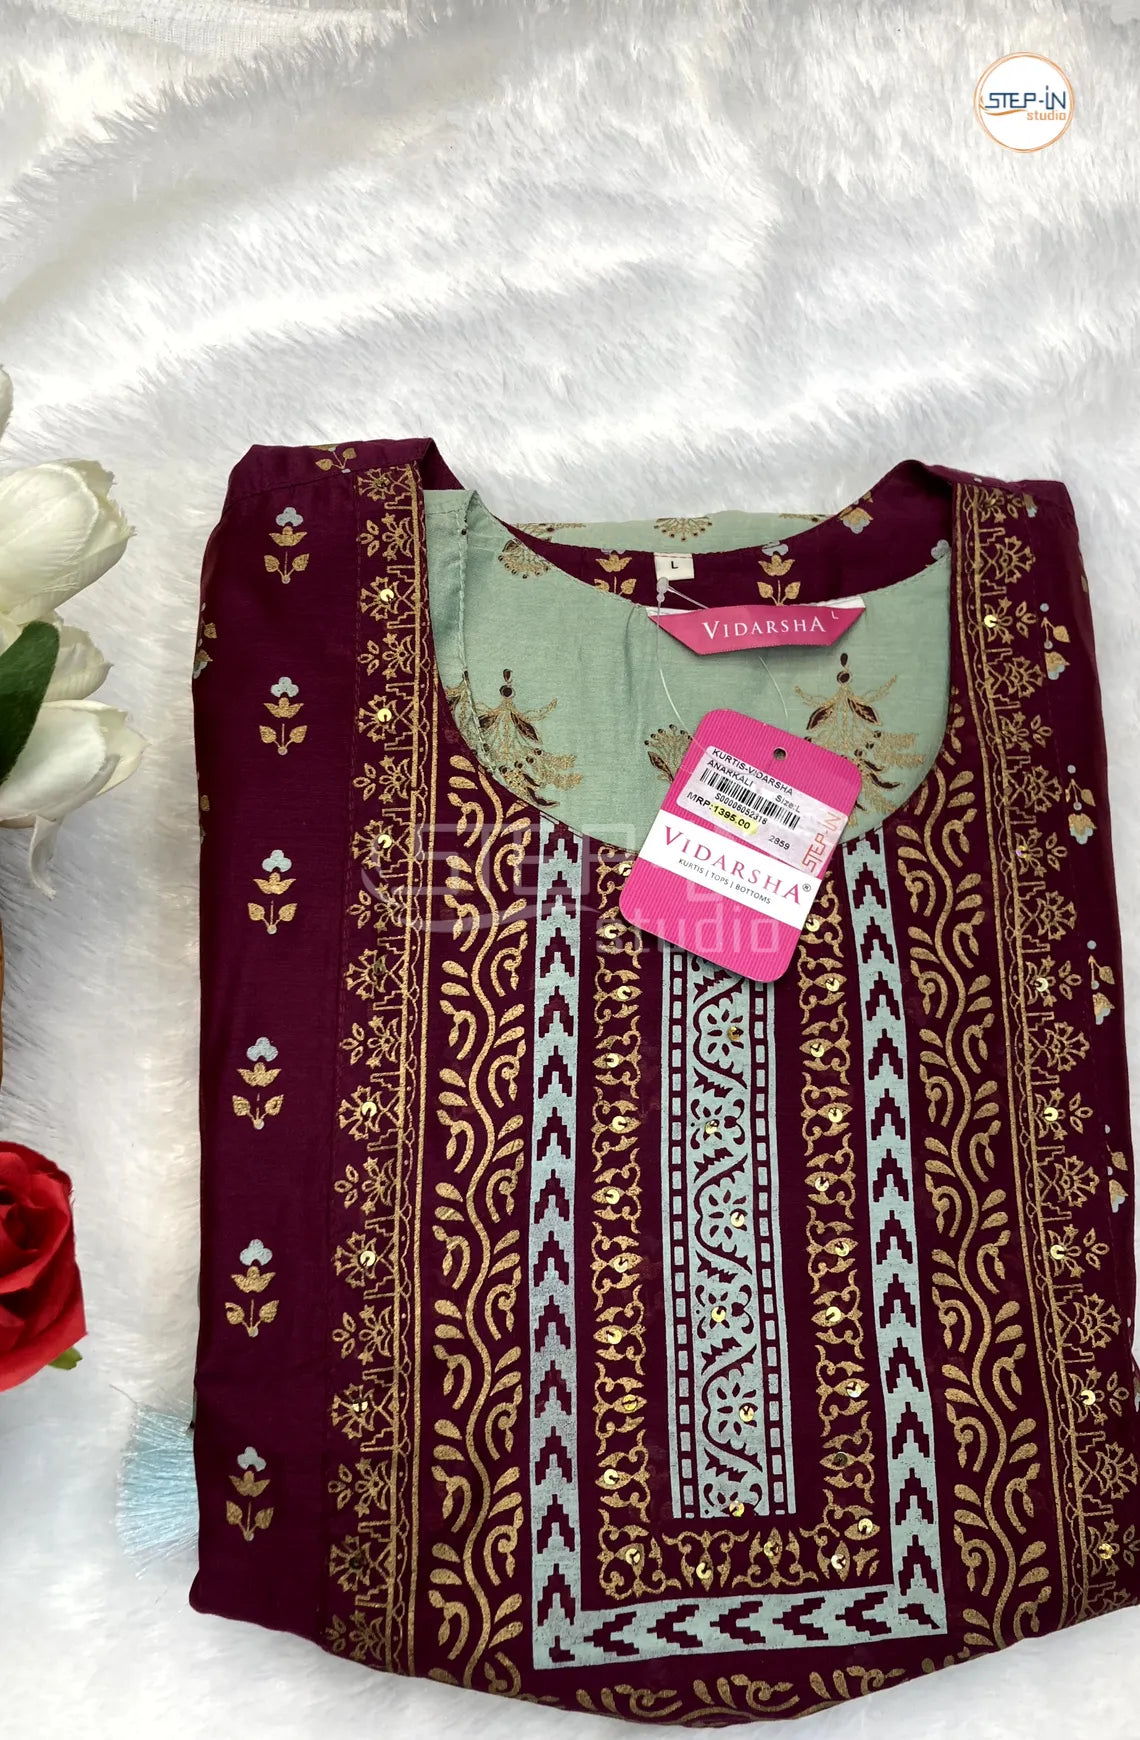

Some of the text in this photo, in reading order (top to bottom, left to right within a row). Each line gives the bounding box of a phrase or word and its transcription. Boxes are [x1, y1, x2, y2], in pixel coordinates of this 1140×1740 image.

[670, 560, 679, 570] L
[702, 615, 827, 640] VIDARSHA
[831, 610, 839, 620] L
[707, 760, 754, 788] ANARKALI
[712, 748, 793, 796] KURTIS-VIDARSHA
[686, 791, 751, 830] MRP:1395.00
[768, 835, 791, 850] 2859
[678, 858, 771, 905] KURTIS TOPS BOTTOMS
